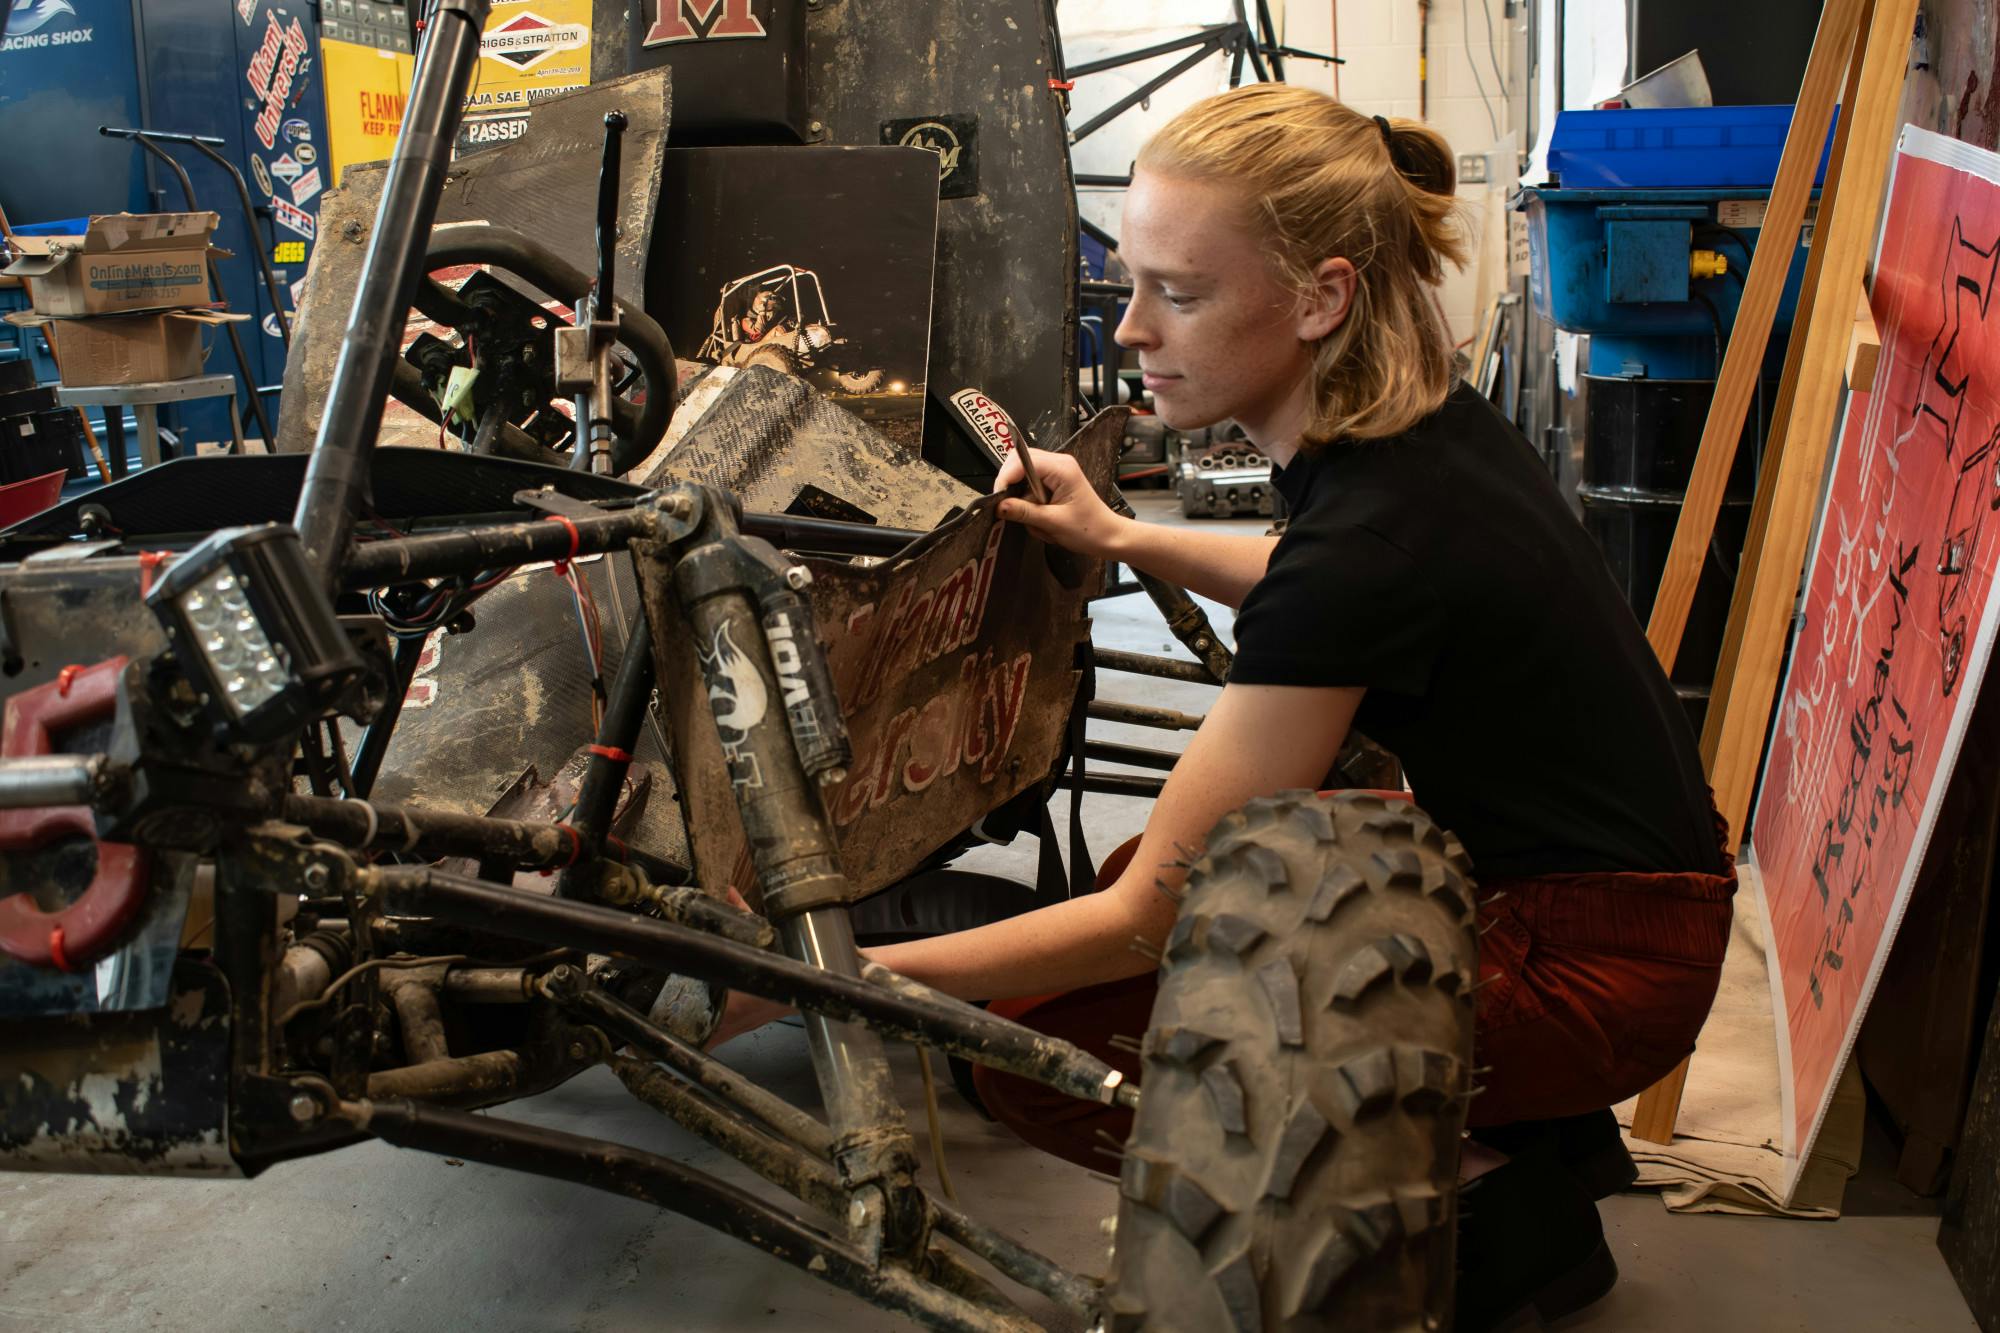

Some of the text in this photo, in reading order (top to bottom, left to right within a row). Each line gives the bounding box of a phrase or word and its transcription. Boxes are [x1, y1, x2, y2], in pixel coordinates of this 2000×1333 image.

[0, 28, 93, 51] ACING SHOX
[246, 8, 285, 101] Miami
[480, 37, 514, 48] RIGGS
[523, 31, 578, 44] STRATTON
[254, 16, 308, 150] University
[496, 91, 521, 103] SAE
[527, 85, 585, 101] MARYLA
[363, 121, 385, 135] KEEP
[90, 262, 201, 280] OnlineMetals.com
[963, 400, 998, 441] RACING
[1843, 400, 1924, 689] Luck
[1785, 500, 1868, 806] Good
[1812, 541, 1921, 908] Redhawk
[1810, 694, 1914, 1010] Racing!
